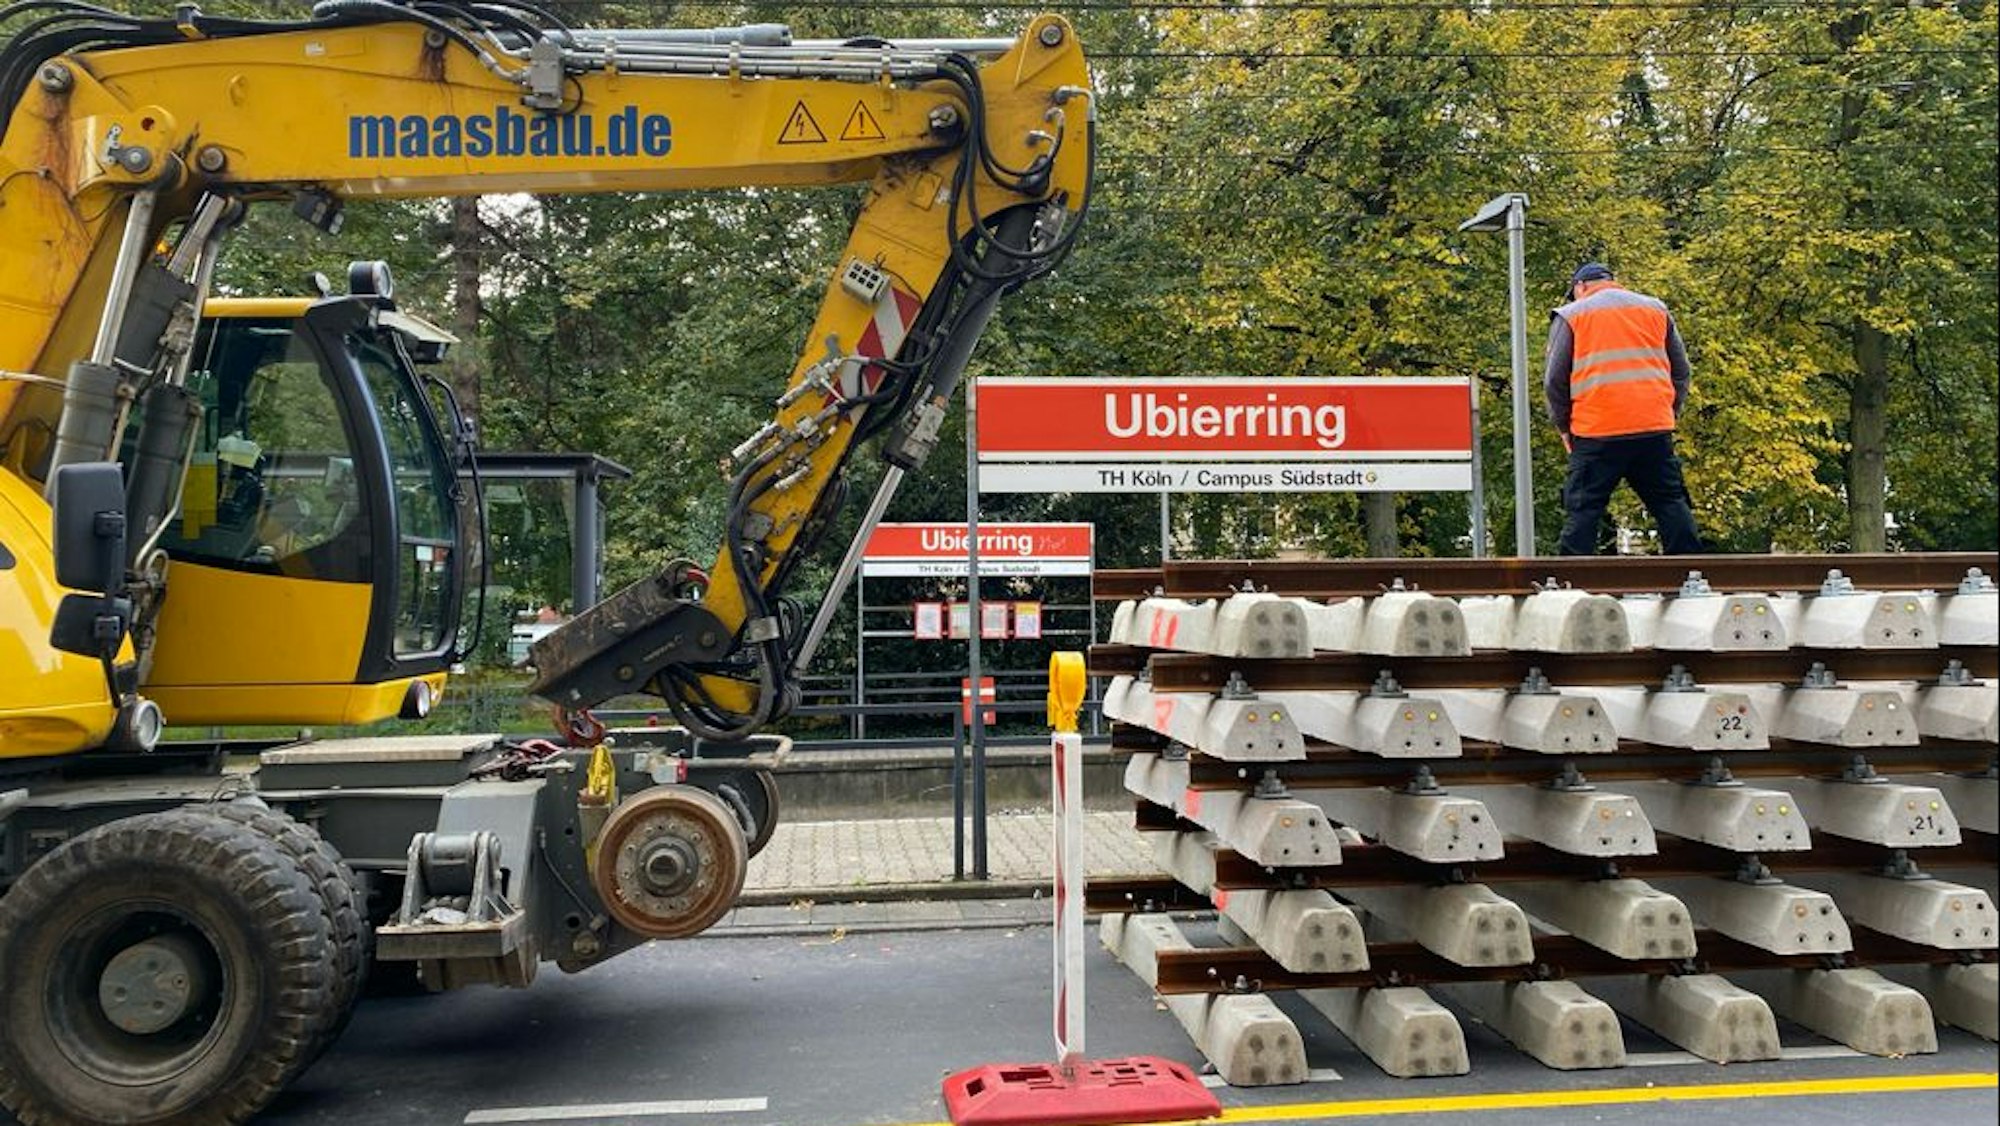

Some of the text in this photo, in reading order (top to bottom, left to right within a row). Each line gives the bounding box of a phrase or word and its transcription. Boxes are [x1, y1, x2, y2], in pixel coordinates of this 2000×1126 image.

[349, 106, 672, 158] maasbau.de
[1104, 393, 1346, 448] Ubierring
[1098, 469, 1363, 488] TH Köln / Campus Südstadt
[1721, 716, 1743, 730] 22
[1914, 816, 1934, 830] 21
